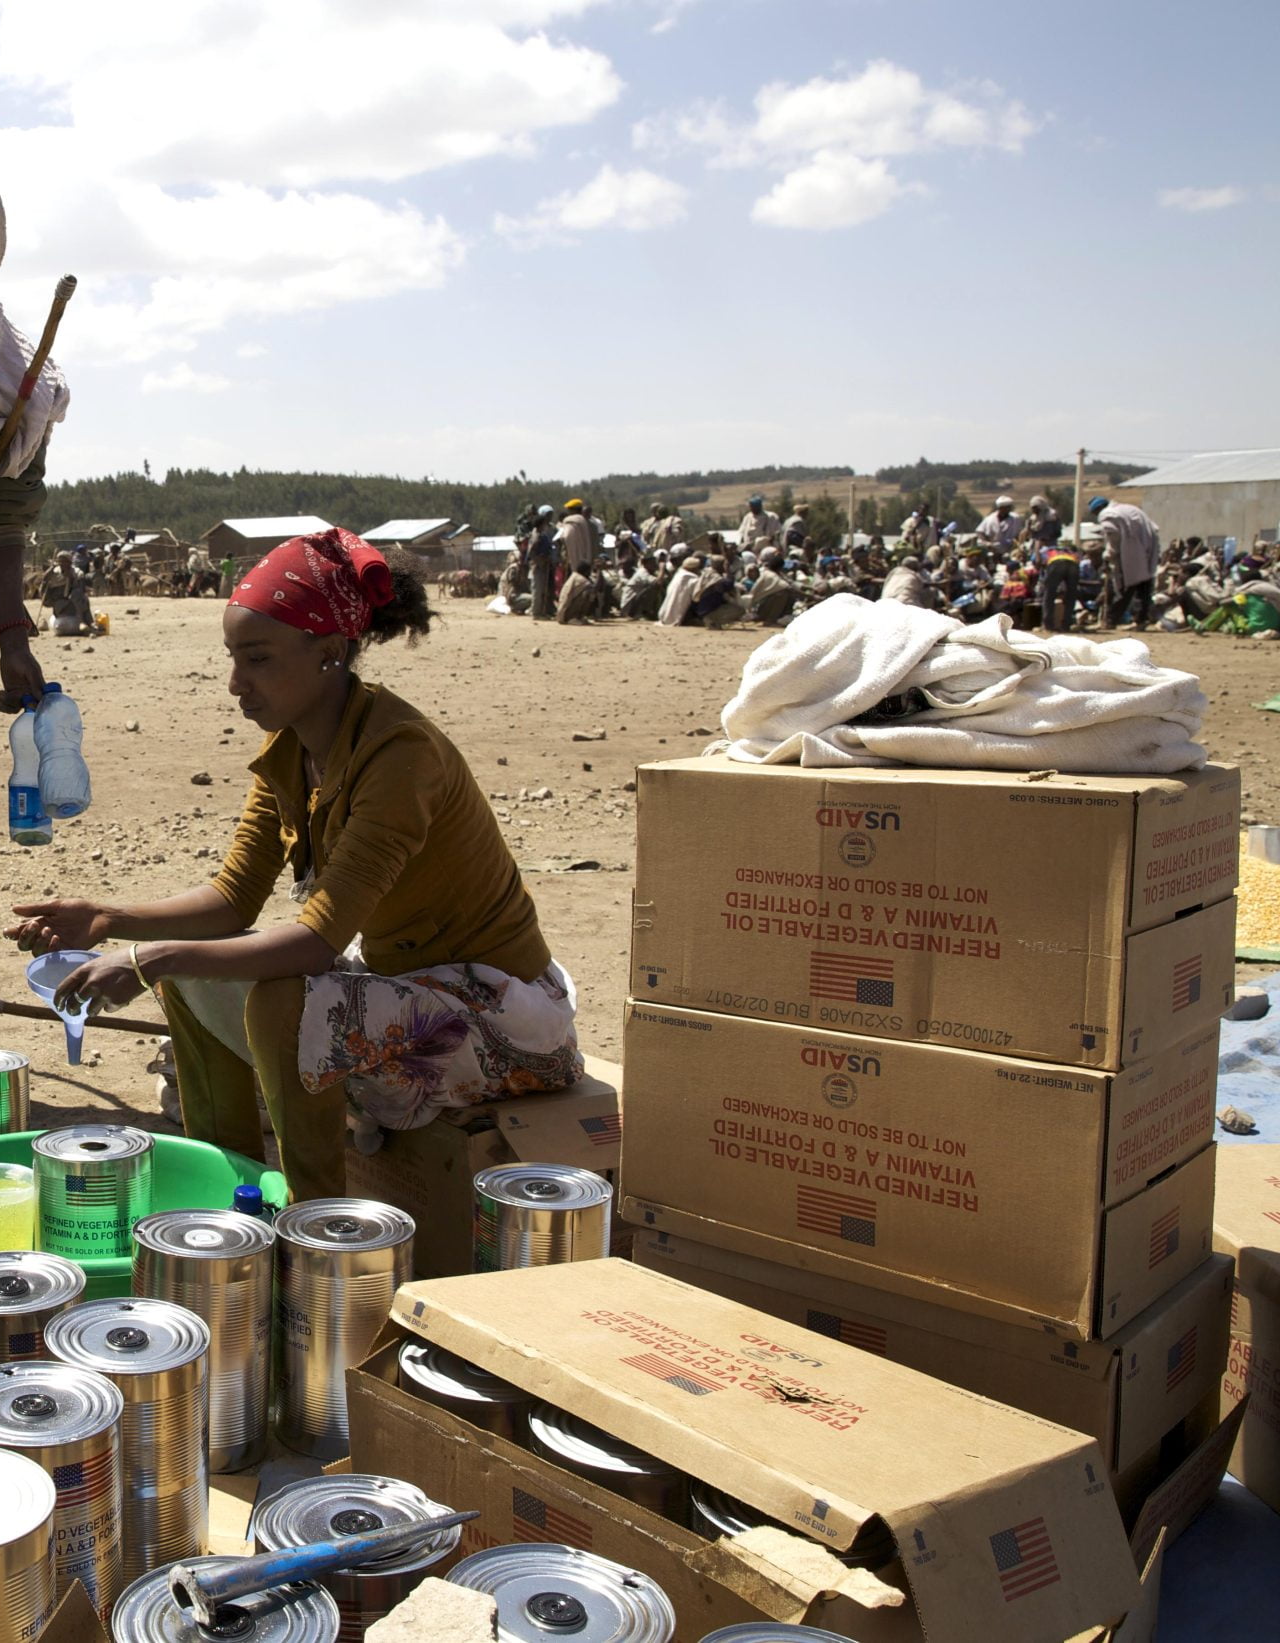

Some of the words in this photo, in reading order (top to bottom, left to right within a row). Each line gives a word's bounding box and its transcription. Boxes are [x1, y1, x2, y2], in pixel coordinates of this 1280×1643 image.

[1085, 797, 1119, 807] CUBIC
[816, 808, 900, 831] USAID
[1146, 851, 1189, 880] FORTIFIED
[1208, 859, 1235, 884] REFINED
[735, 867, 823, 889] EXCHANGED
[827, 876, 850, 892] OR
[854, 877, 897, 896] SOLD
[1158, 869, 1207, 901] VEGETABLE
[901, 882, 922, 898] BE
[928, 884, 949, 900] TO
[953, 886, 988, 904] NOT
[1143, 885, 1158, 905] OIL
[725, 891, 829, 918] FORTIFIED
[838, 903, 852, 920] D
[861, 904, 874, 922] &
[720, 912, 753, 932] OIL
[883, 906, 898, 924] A
[905, 908, 998, 935] VITAMIN
[758, 916, 888, 947] VEGETABLE
[892, 931, 1000, 959] REFINED
[706, 990, 769, 1012] 02/2017
[774, 1001, 811, 1019] BUB
[657, 1015, 687, 1028] WEIGHT:
[688, 1020, 712, 1031] GROSS
[820, 1006, 904, 1032] SX2UA06
[916, 1019, 1013, 1047] 4210002050
[800, 1047, 881, 1077] USAID
[1032, 1075, 1073, 1091] WEIGHT:
[1075, 1082, 1094, 1093] NET
[722, 1096, 808, 1126] EXCHANGED
[812, 1114, 834, 1130] OR
[837, 1119, 878, 1140] SOLD
[1179, 1111, 1210, 1146] REFINED
[713, 1119, 815, 1154] FORTIFIED
[882, 1127, 903, 1145] BE
[907, 1132, 929, 1150] TO
[1117, 1120, 1161, 1161] FORTIFIED
[709, 1138, 741, 1159] OIL
[822, 1141, 836, 1158] D
[844, 1144, 857, 1162] &
[932, 1137, 966, 1157] NOT
[1129, 1134, 1179, 1177] VEGETABLE
[745, 1146, 871, 1189] VEGETABLE
[865, 1150, 880, 1167] A
[886, 1153, 977, 1189] VITAMIN
[1113, 1162, 1128, 1185] OIL
[875, 1174, 979, 1213] REFINED
[44, 1214, 75, 1228] REFINED
[76, 1217, 129, 1230] VEGETABLE
[44, 1226, 72, 1239] VITAMIN
[73, 1232, 81, 1240] A
[82, 1232, 89, 1241] &
[91, 1232, 98, 1240] D
[579, 1310, 612, 1326] OIL
[596, 1310, 701, 1354] FORTIFIED
[623, 1311, 711, 1348] EXCHANGED
[610, 1326, 738, 1384] VEGETABLE
[703, 1356, 721, 1364] D
[711, 1348, 735, 1359] OR
[740, 1333, 824, 1368] USAID
[726, 1364, 742, 1372] &
[736, 1358, 780, 1376] SOLD
[779, 1376, 805, 1386] BE
[806, 1386, 828, 1398] TO
[794, 1510, 811, 1526] THIS
[811, 1519, 826, 1534] END
[826, 1527, 838, 1538] UP
[66, 1543, 75, 1555] A
[89, 1536, 96, 1547] D
